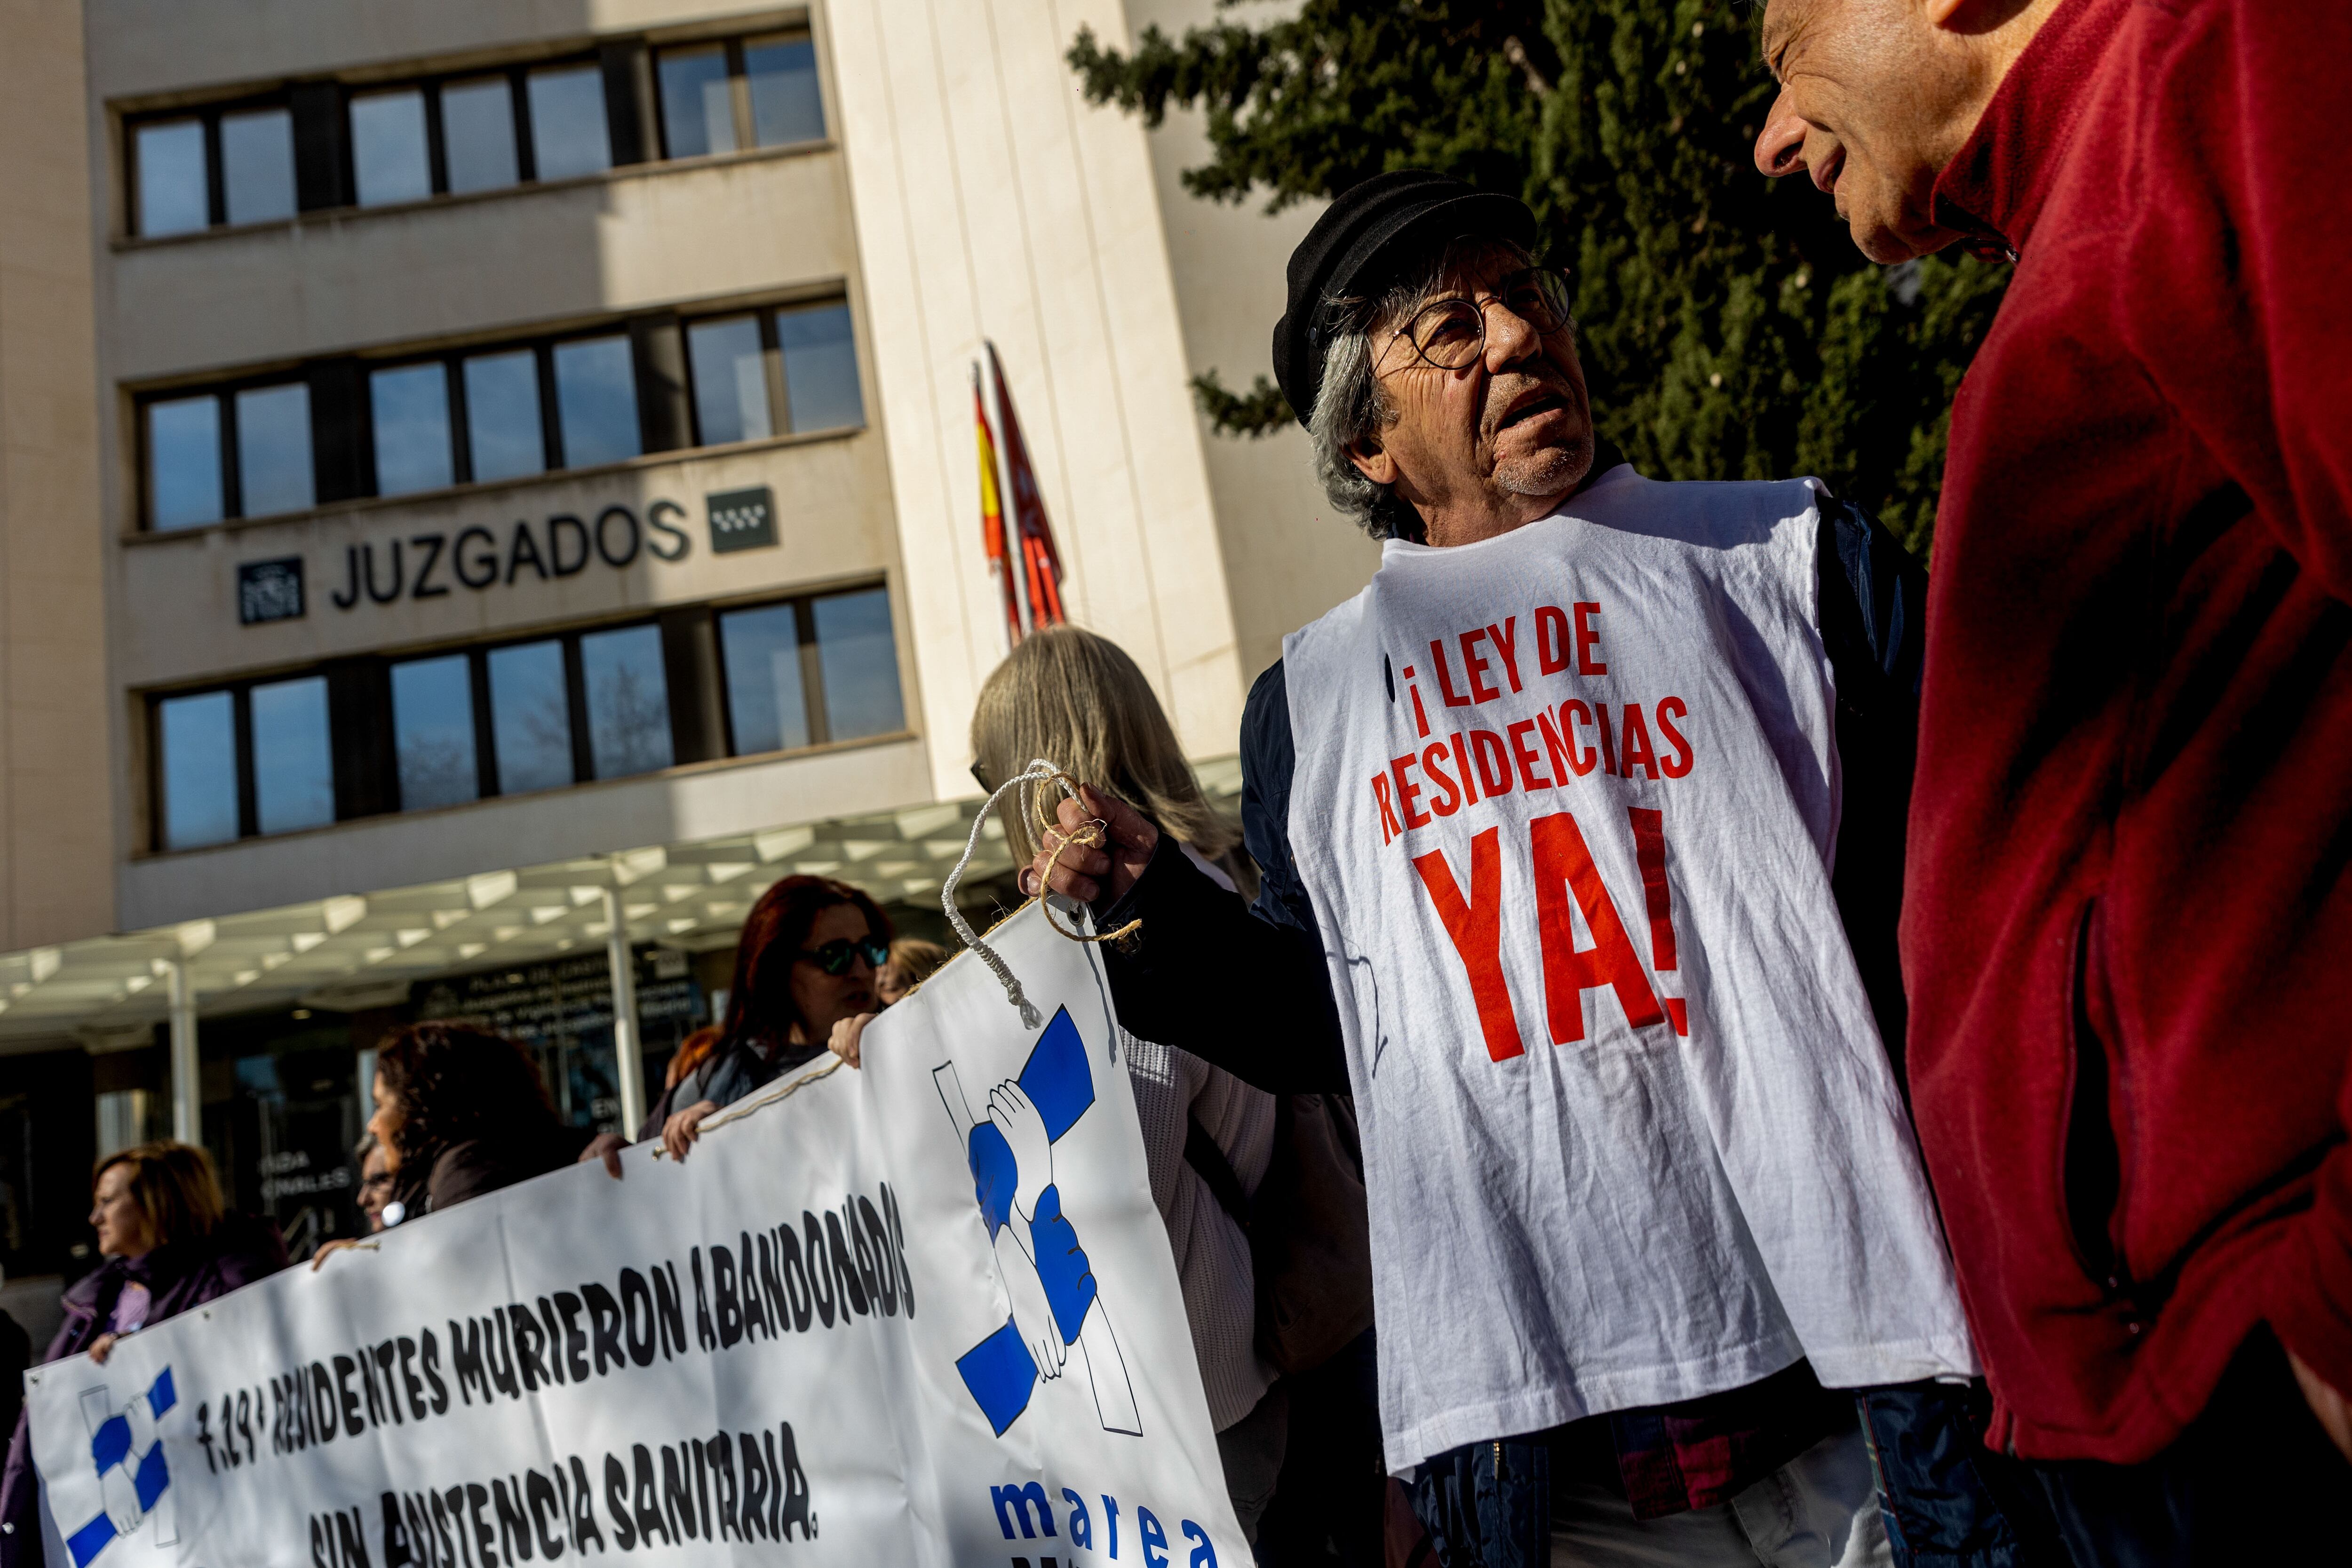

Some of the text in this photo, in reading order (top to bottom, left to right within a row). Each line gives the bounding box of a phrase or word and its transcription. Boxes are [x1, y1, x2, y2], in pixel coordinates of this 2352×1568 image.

[332, 501, 693, 609] JUZGADOS
[1534, 602, 1607, 677] DE
[1371, 696, 1693, 847] RESIDENCIAS
[1412, 806, 1688, 1062] YA!
[271, 1327, 449, 1455] RESIDENTES
[448, 1260, 686, 1405] MURIERON
[690, 1181, 914, 1353] ABANDONADOS
[310, 1506, 373, 1568] SIN
[381, 1455, 606, 1568] ASISTENCIA
[990, 1481, 1218, 1568] marea
